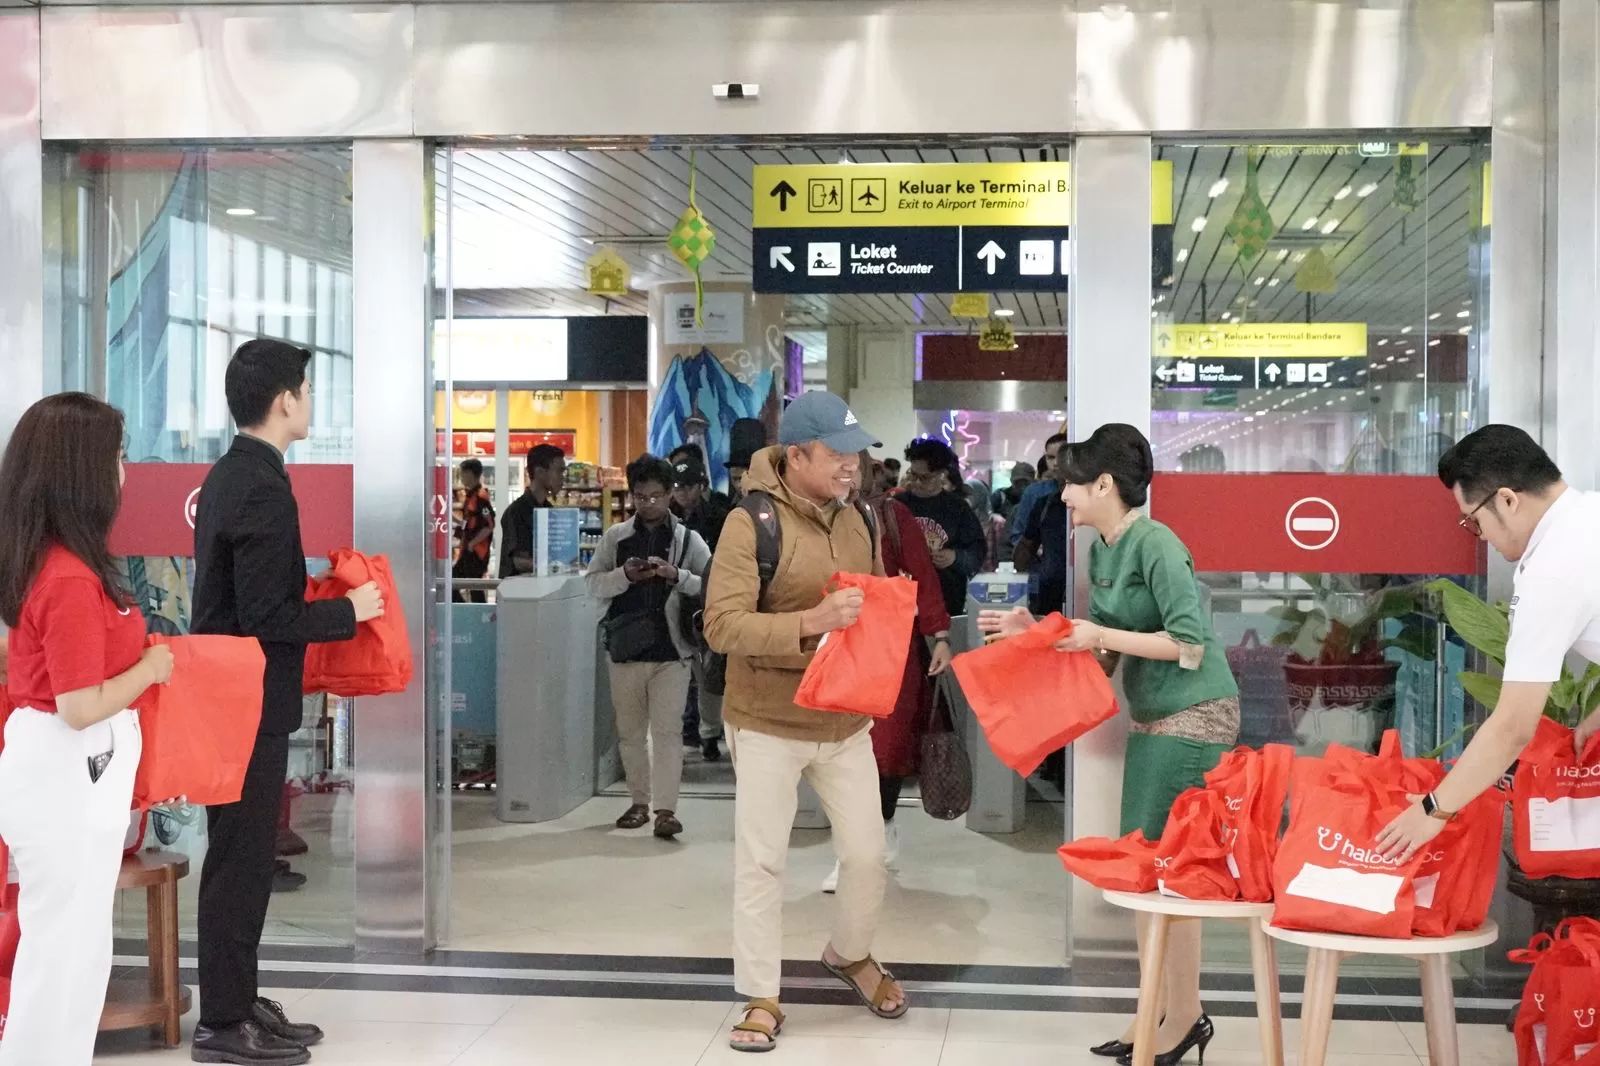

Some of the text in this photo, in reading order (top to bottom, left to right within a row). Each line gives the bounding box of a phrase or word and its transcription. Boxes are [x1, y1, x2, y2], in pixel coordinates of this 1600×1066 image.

[899, 180, 951, 194] Keluar
[956, 180, 975, 194] ke
[980, 180, 1051, 194] Terminal
[898, 199, 1028, 211] Exit to Airport Terminal
[850, 243, 897, 259] Loket
[850, 262, 934, 274] Ticket Counter
[1267, 333, 1304, 341] Terminal
[532, 389, 564, 401] fresh!
